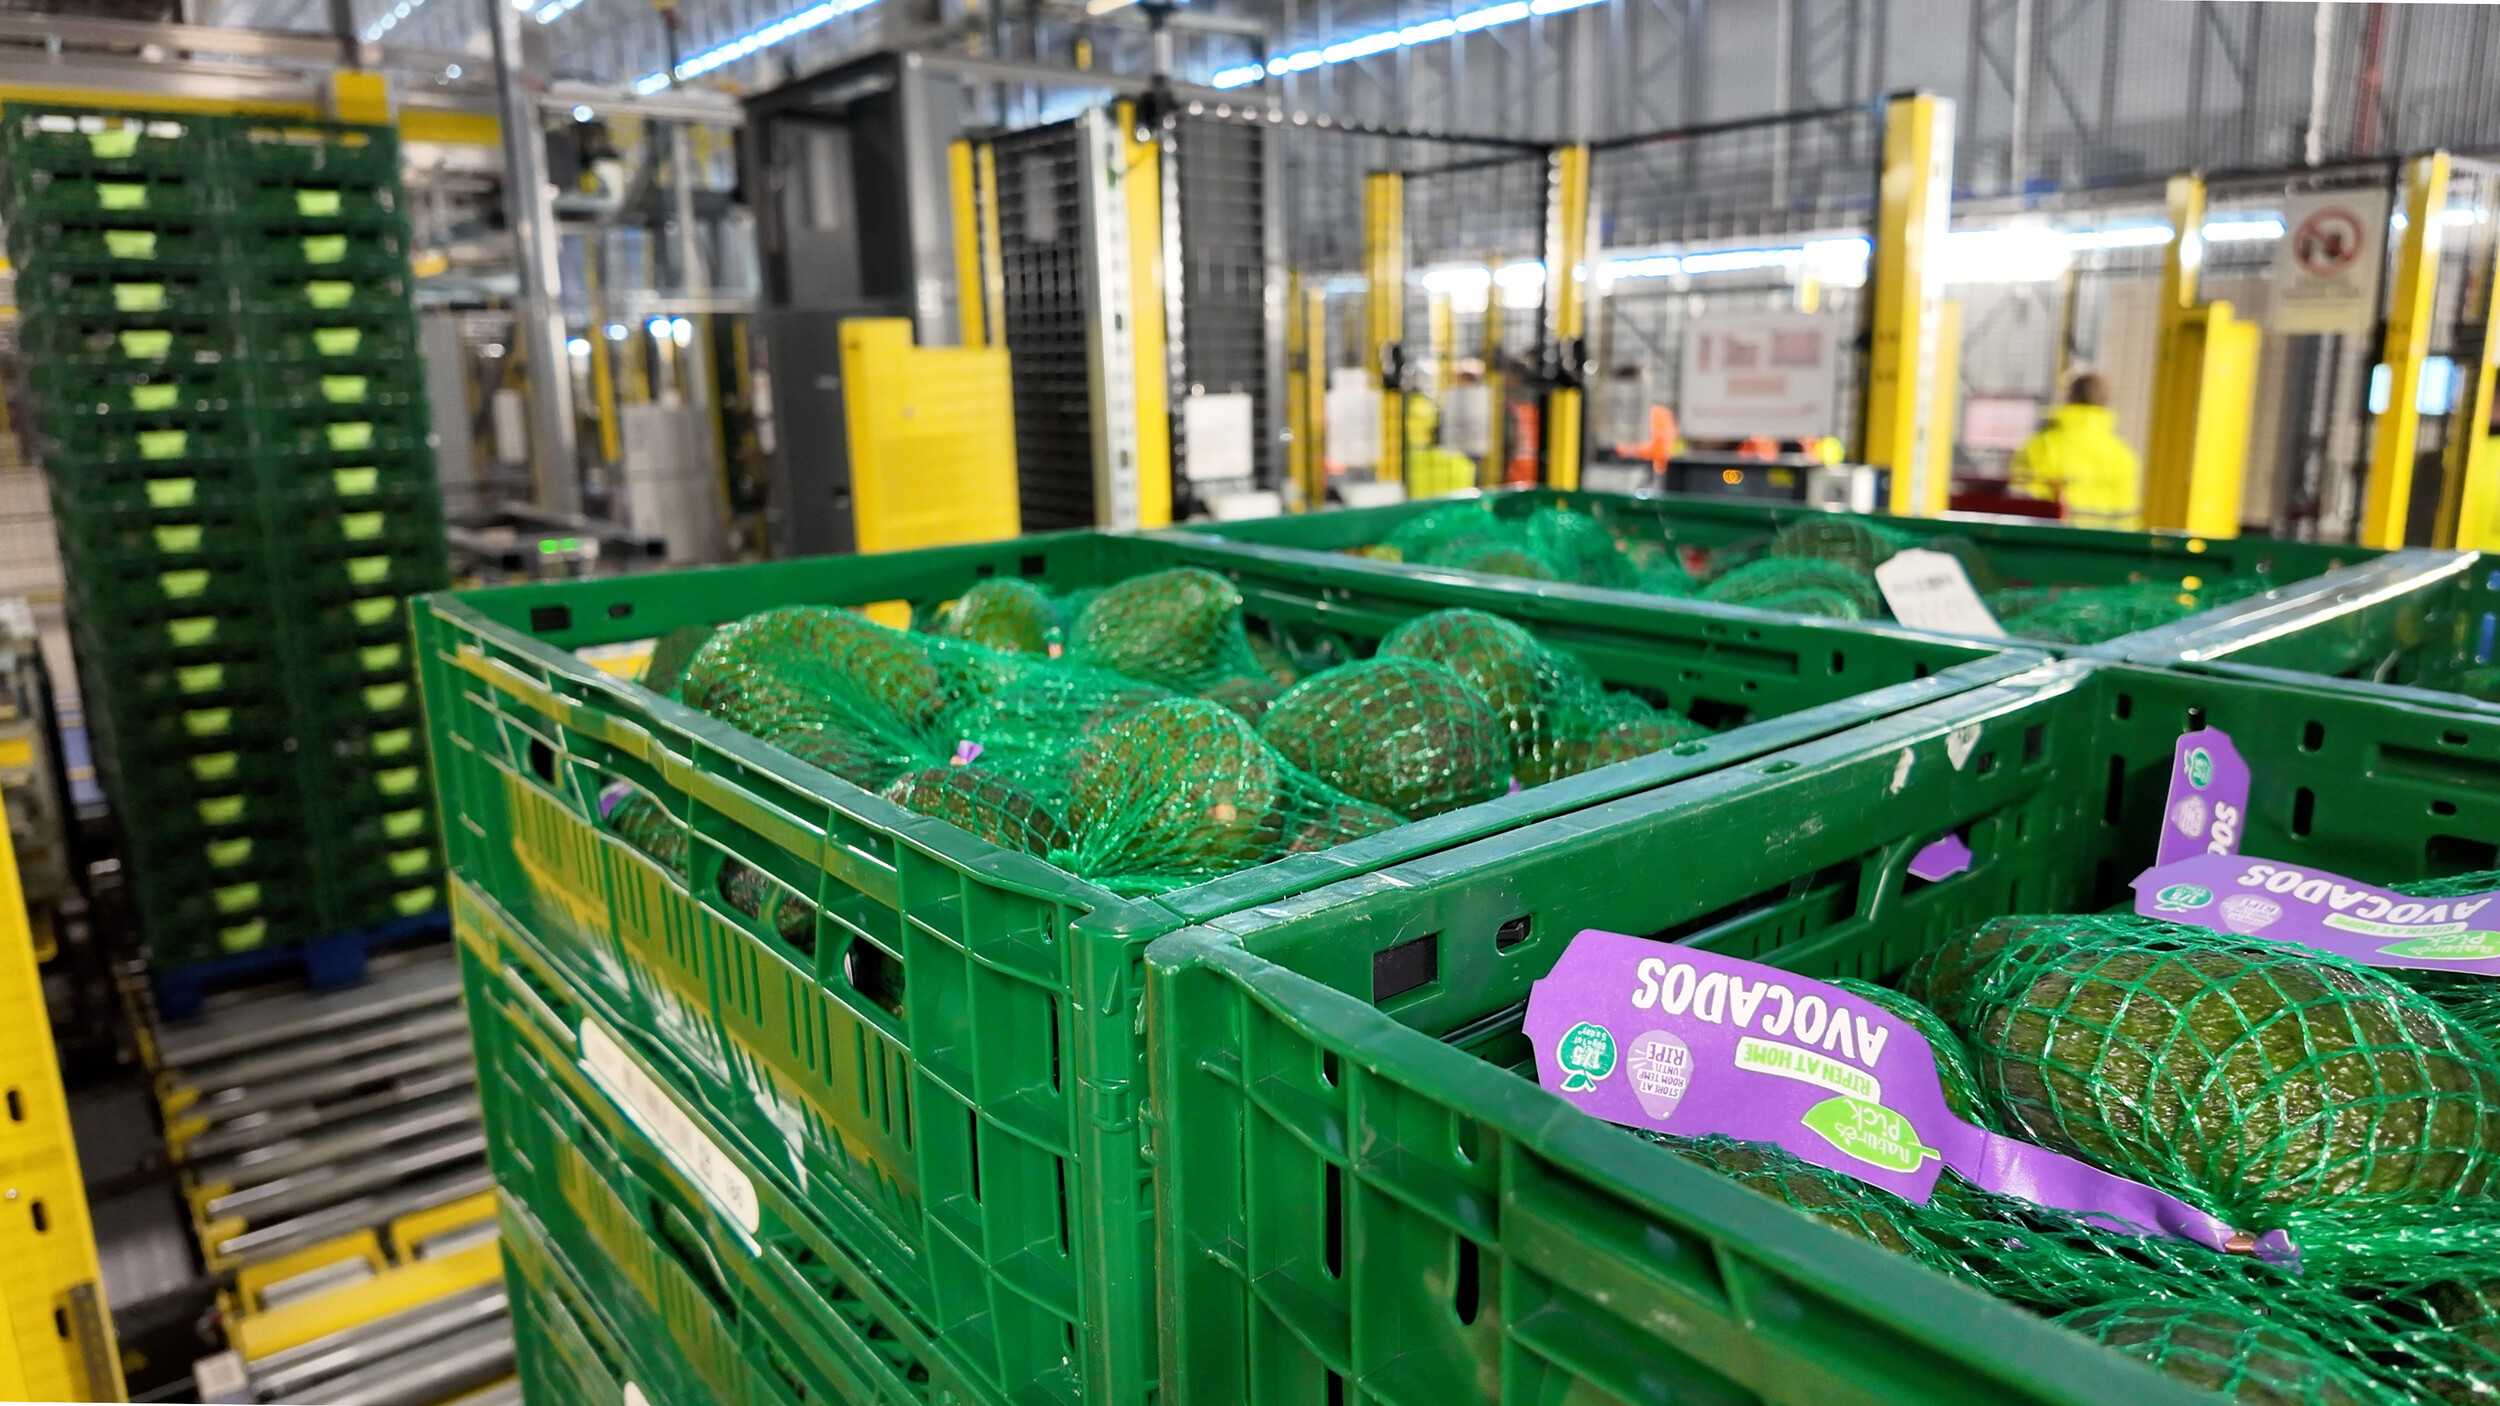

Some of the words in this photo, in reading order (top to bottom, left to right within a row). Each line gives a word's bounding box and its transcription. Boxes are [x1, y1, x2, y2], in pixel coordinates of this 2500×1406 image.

[2236, 863, 2493, 925] AVOCADOS
[1630, 956, 1889, 1069] AVOCADOS
[1646, 1043, 1685, 1066] RIPE
[1743, 1042, 1793, 1067] HOME
[1795, 1053, 1820, 1075] AT
[1639, 1071, 1660, 1083] TEMP
[1654, 1063, 1679, 1075] UNTIL
[1821, 1063, 1871, 1096] RIPEN
[1642, 1082, 1653, 1091] AT
[1654, 1085, 1679, 1097] STORE
[1661, 1074, 1684, 1087] ROOM
[1843, 1099, 1901, 1141] Pick
